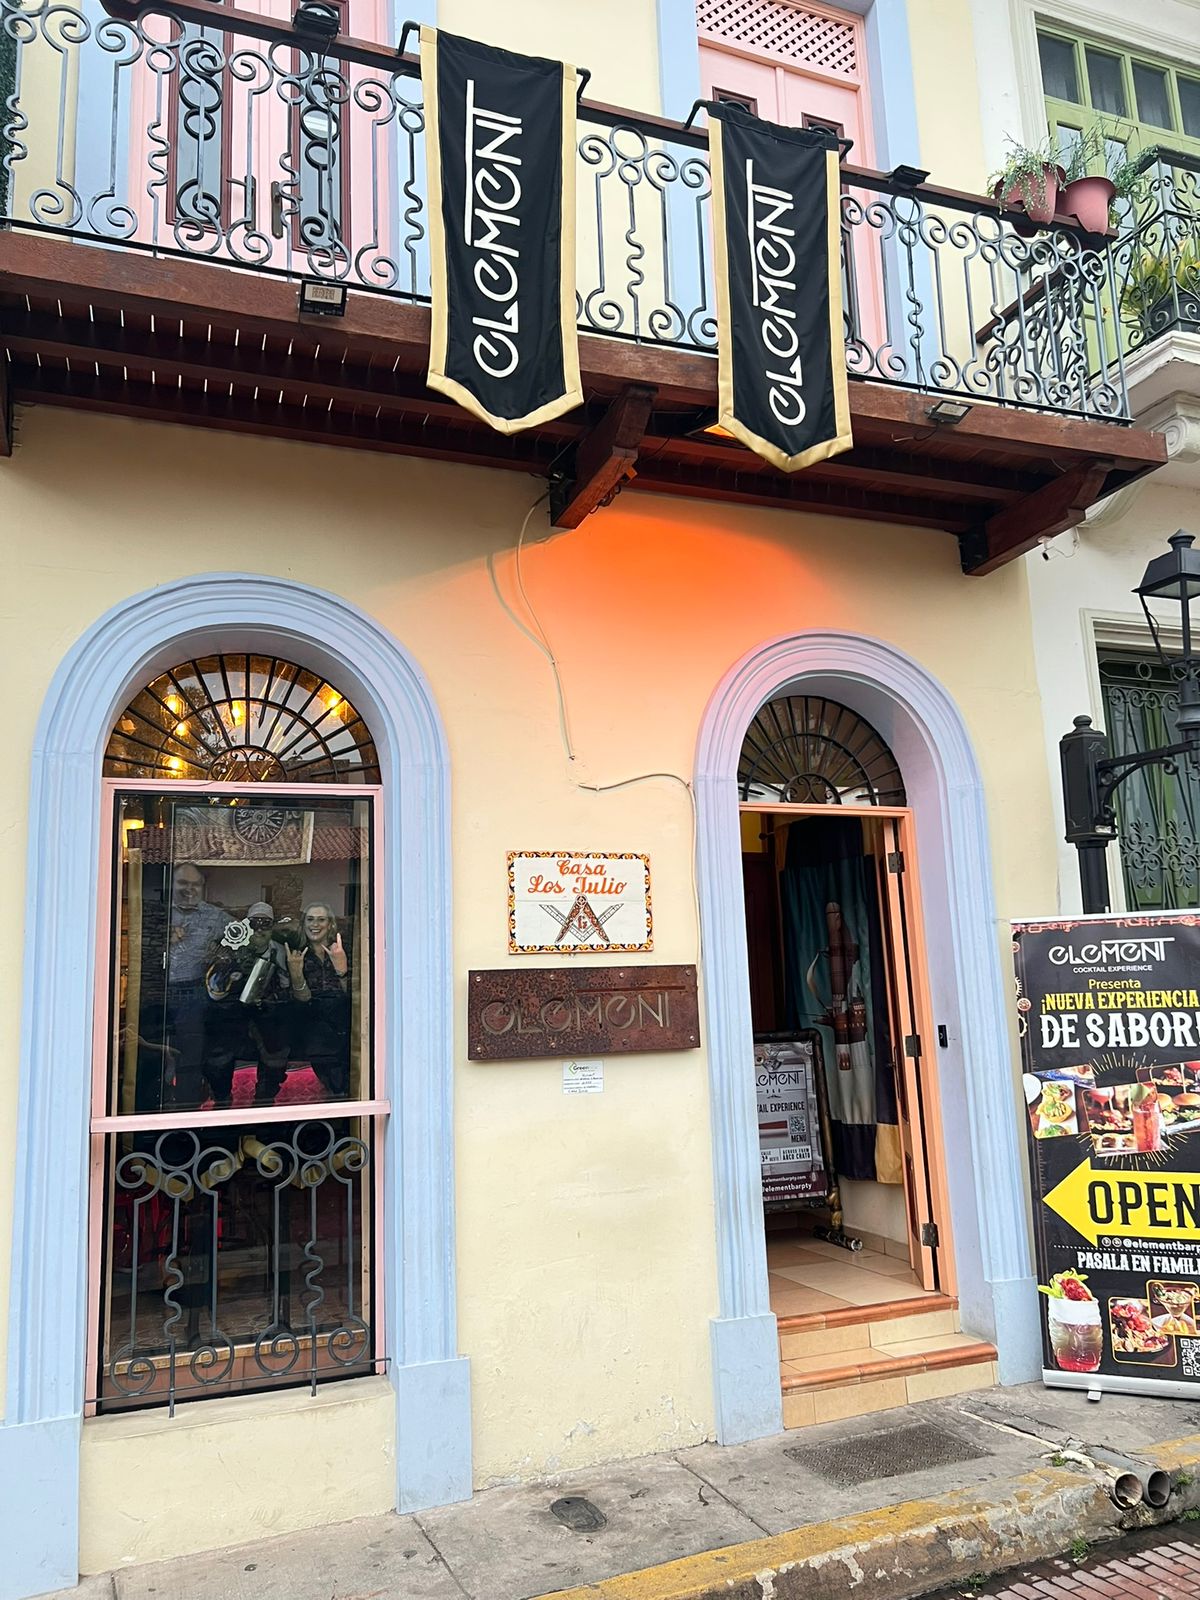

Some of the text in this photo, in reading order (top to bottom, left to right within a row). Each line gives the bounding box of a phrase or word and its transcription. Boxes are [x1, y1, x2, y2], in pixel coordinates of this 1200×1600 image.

[557, 859, 607, 876] Casa
[528, 874, 627, 895] Los Julio
[1073, 964, 1153, 974] COCKTAIL EXPERIENCE
[1088, 978, 1142, 990] Presenta
[1097, 989, 1200, 1010] EXPERIENCIA
[1039, 1012, 1081, 1049] DE
[1087, 1180, 1200, 1229] OPEN
[1077, 1251, 1130, 1271] PASALA
[1131, 1254, 1151, 1273] EN
